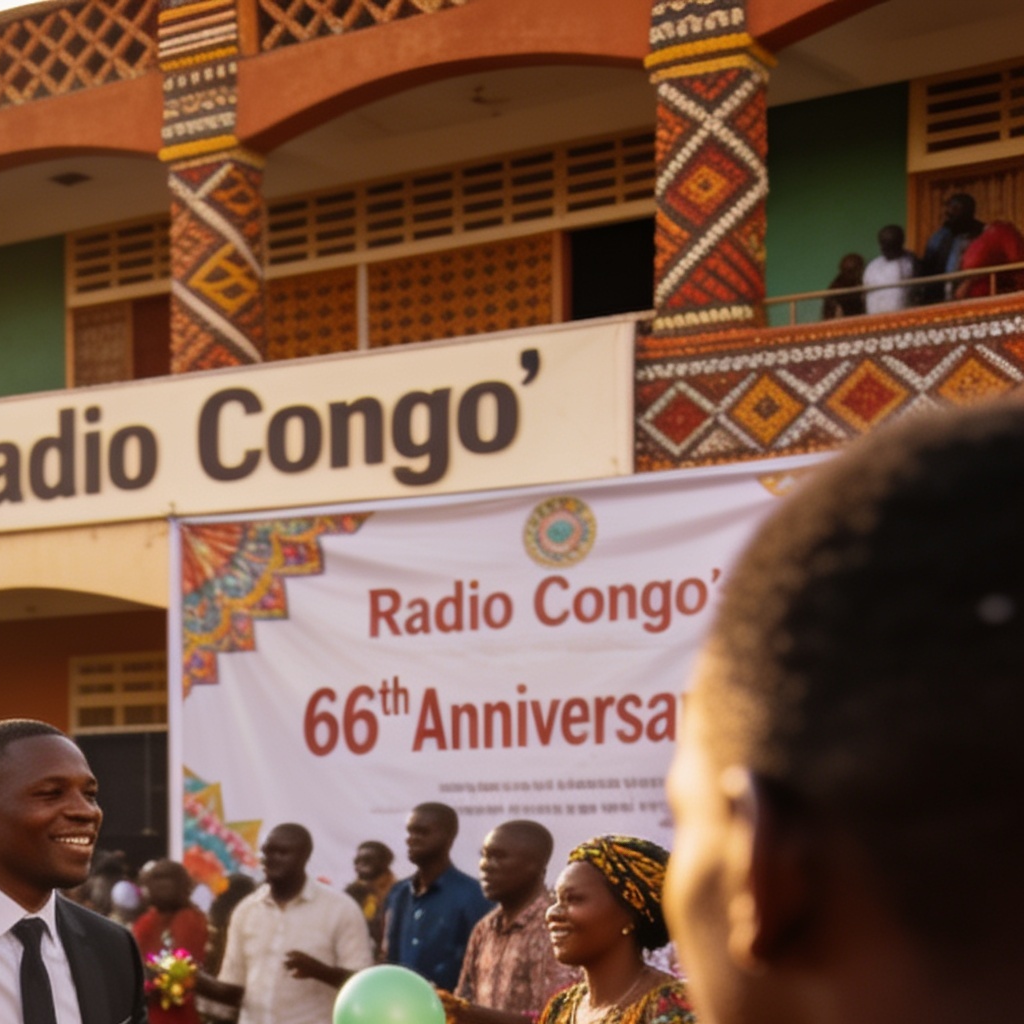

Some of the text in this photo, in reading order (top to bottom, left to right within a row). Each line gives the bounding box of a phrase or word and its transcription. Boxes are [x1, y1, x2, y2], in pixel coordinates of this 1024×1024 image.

[367, 578, 515, 638] Radio
[302, 674, 690, 758] 66th Anniversa
